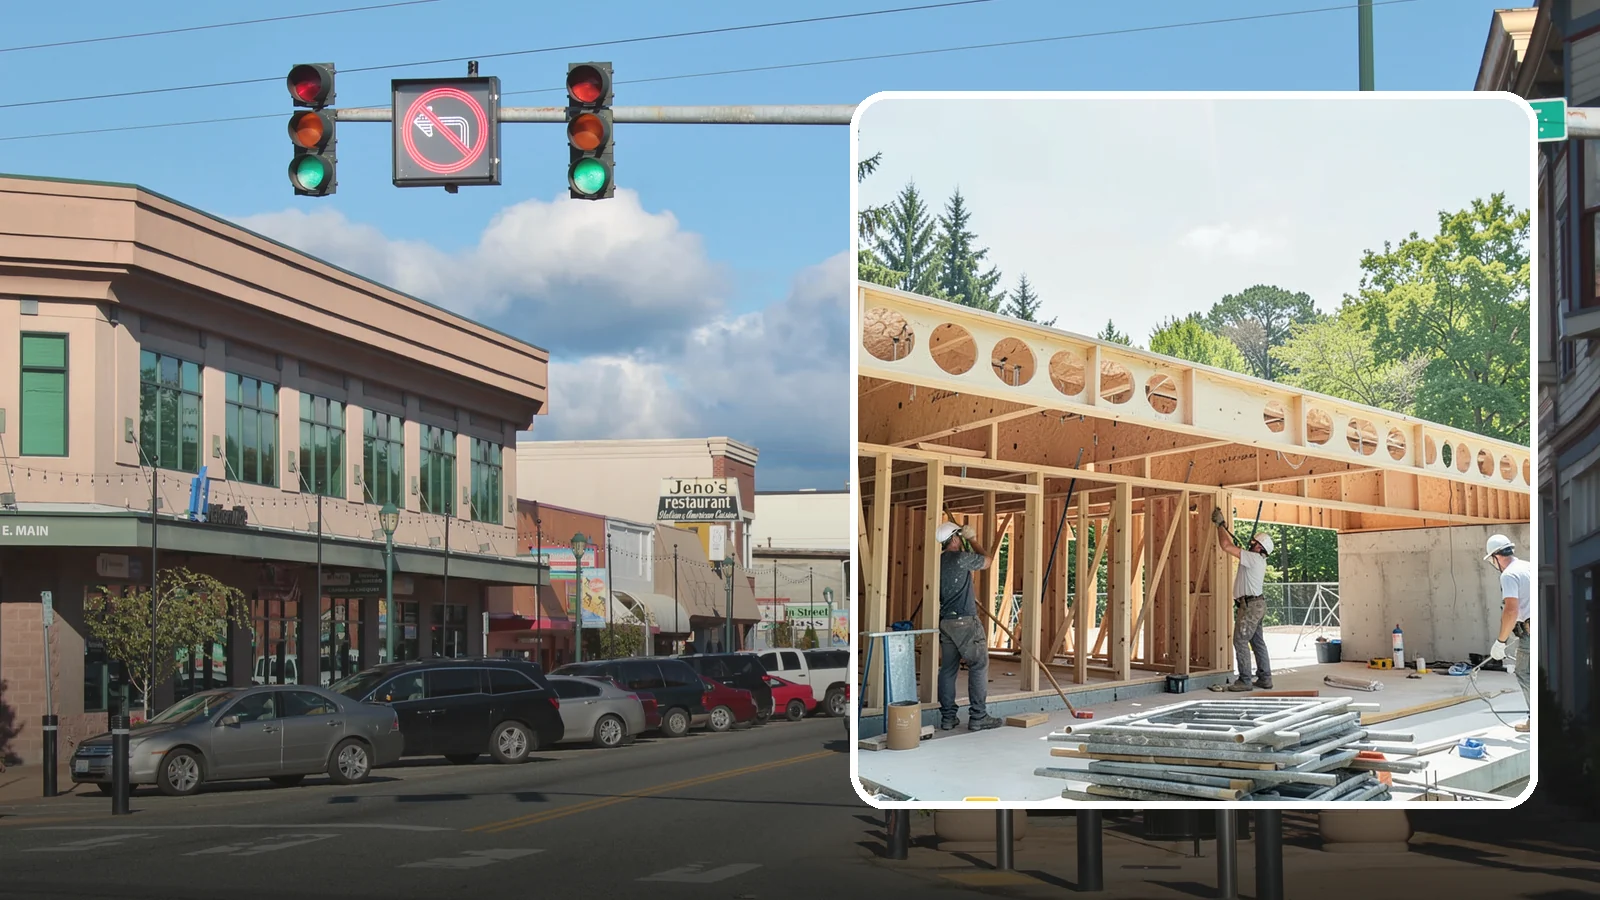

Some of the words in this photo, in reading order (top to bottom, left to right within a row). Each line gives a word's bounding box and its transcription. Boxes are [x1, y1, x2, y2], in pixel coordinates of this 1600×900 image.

[670, 480, 727, 494] Jeno's
[665, 496, 731, 509] restaurant
[659, 510, 681, 519] Italian
[686, 509, 715, 519] American
[715, 509, 737, 519] Cuisine
[2, 525, 13, 536] E.
[15, 525, 49, 536] MAIN
[797, 608, 828, 616] Street
